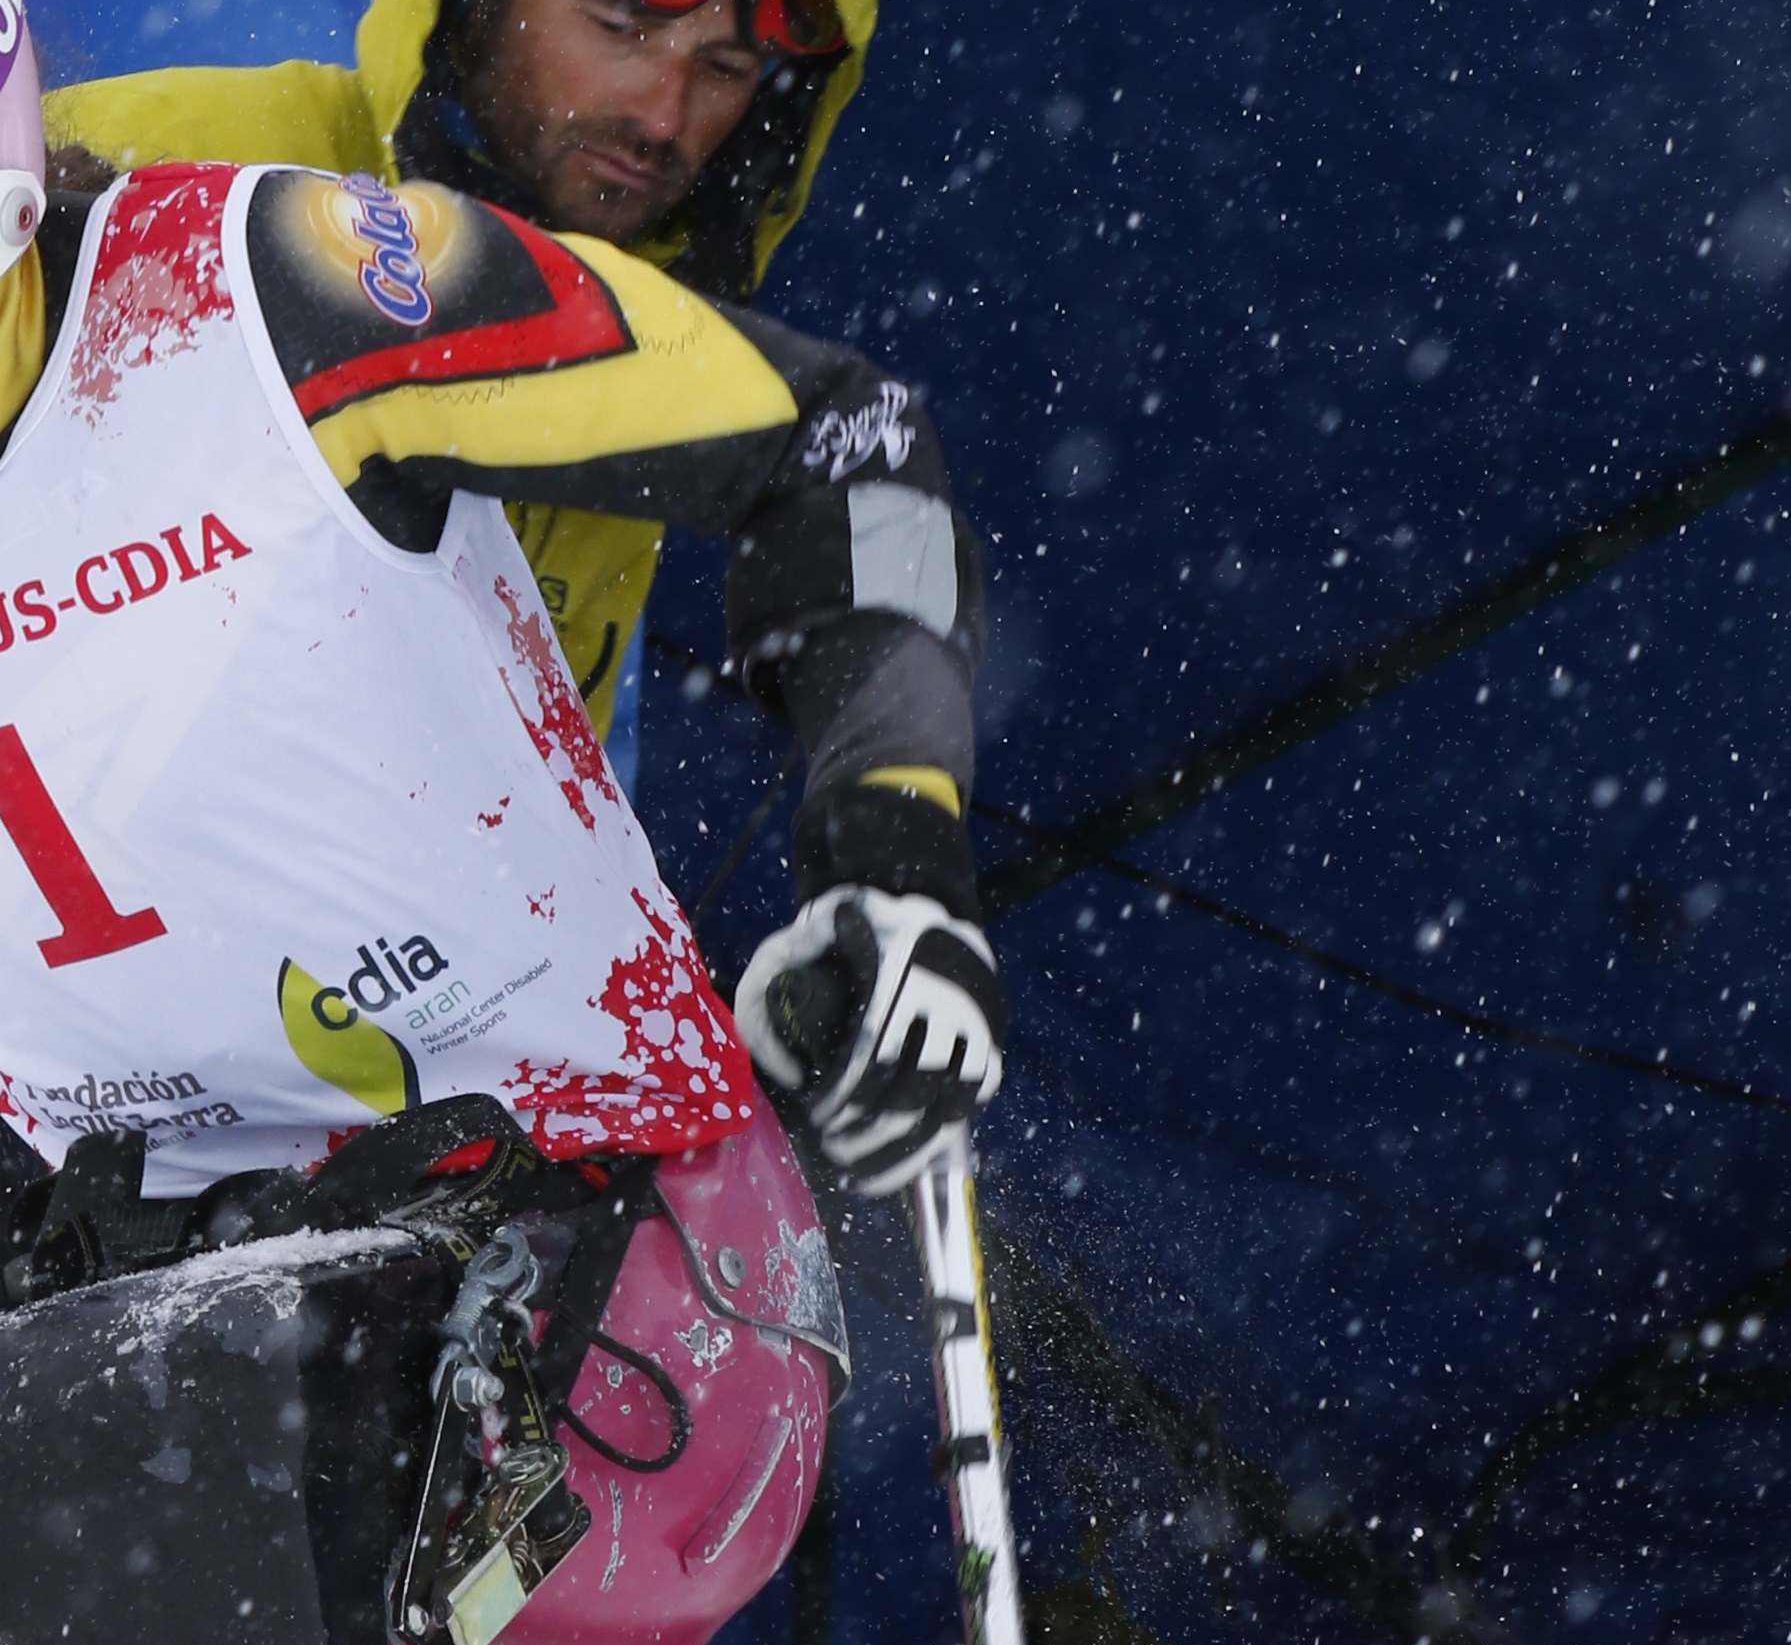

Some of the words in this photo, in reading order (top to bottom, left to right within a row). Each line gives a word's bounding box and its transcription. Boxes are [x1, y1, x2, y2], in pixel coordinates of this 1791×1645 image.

[311, 935, 449, 1031] cdia
[405, 979, 471, 1030] aran
[470, 990, 506, 1018] Center
[504, 957, 553, 994] Disabled
[469, 1009, 507, 1038] Sports
[24, 1070, 208, 1112] ndación
